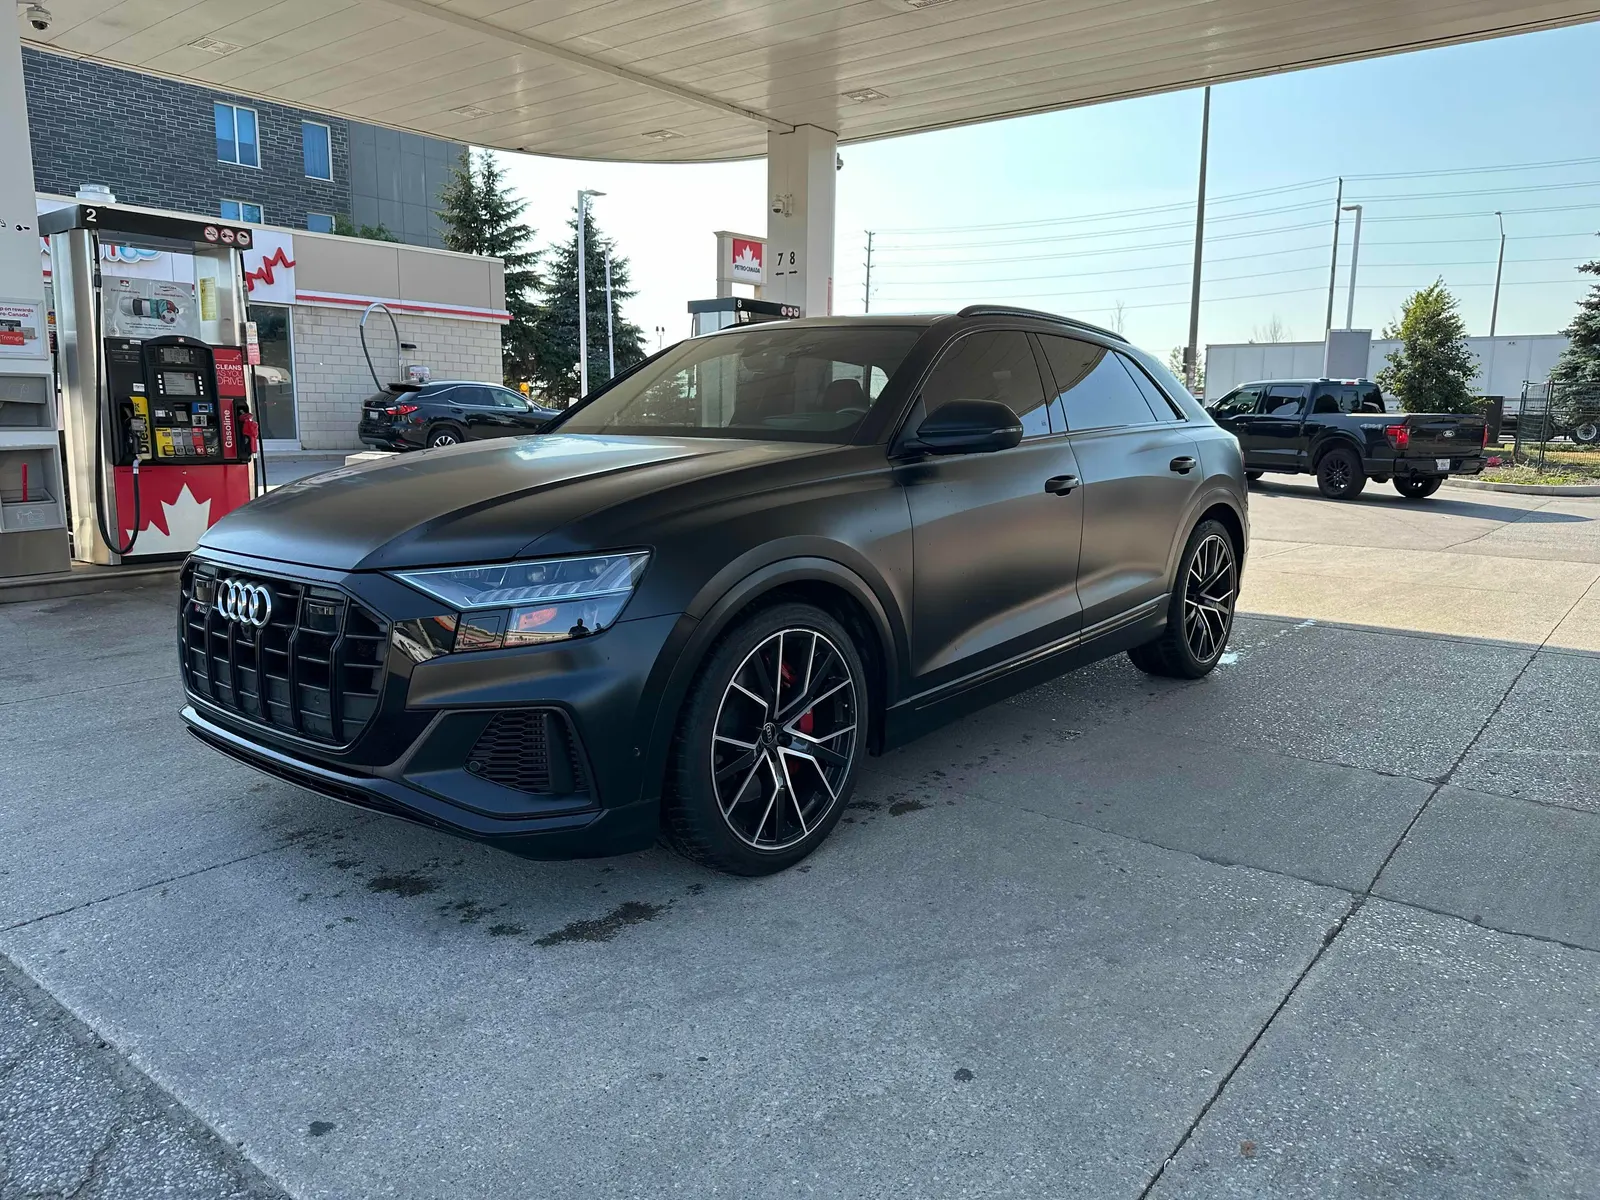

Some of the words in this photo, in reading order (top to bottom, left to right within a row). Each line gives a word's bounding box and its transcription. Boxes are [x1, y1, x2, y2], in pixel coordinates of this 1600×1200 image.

[86, 208, 97, 222] 2
[778, 252, 784, 266] 7
[790, 251, 796, 264] 8
[737, 300, 742, 308] 8
[215, 363, 242, 371] CLEANS
[227, 370, 243, 378] YOU
[217, 376, 244, 386] DRIVE
[224, 410, 232, 448] Gasoline
